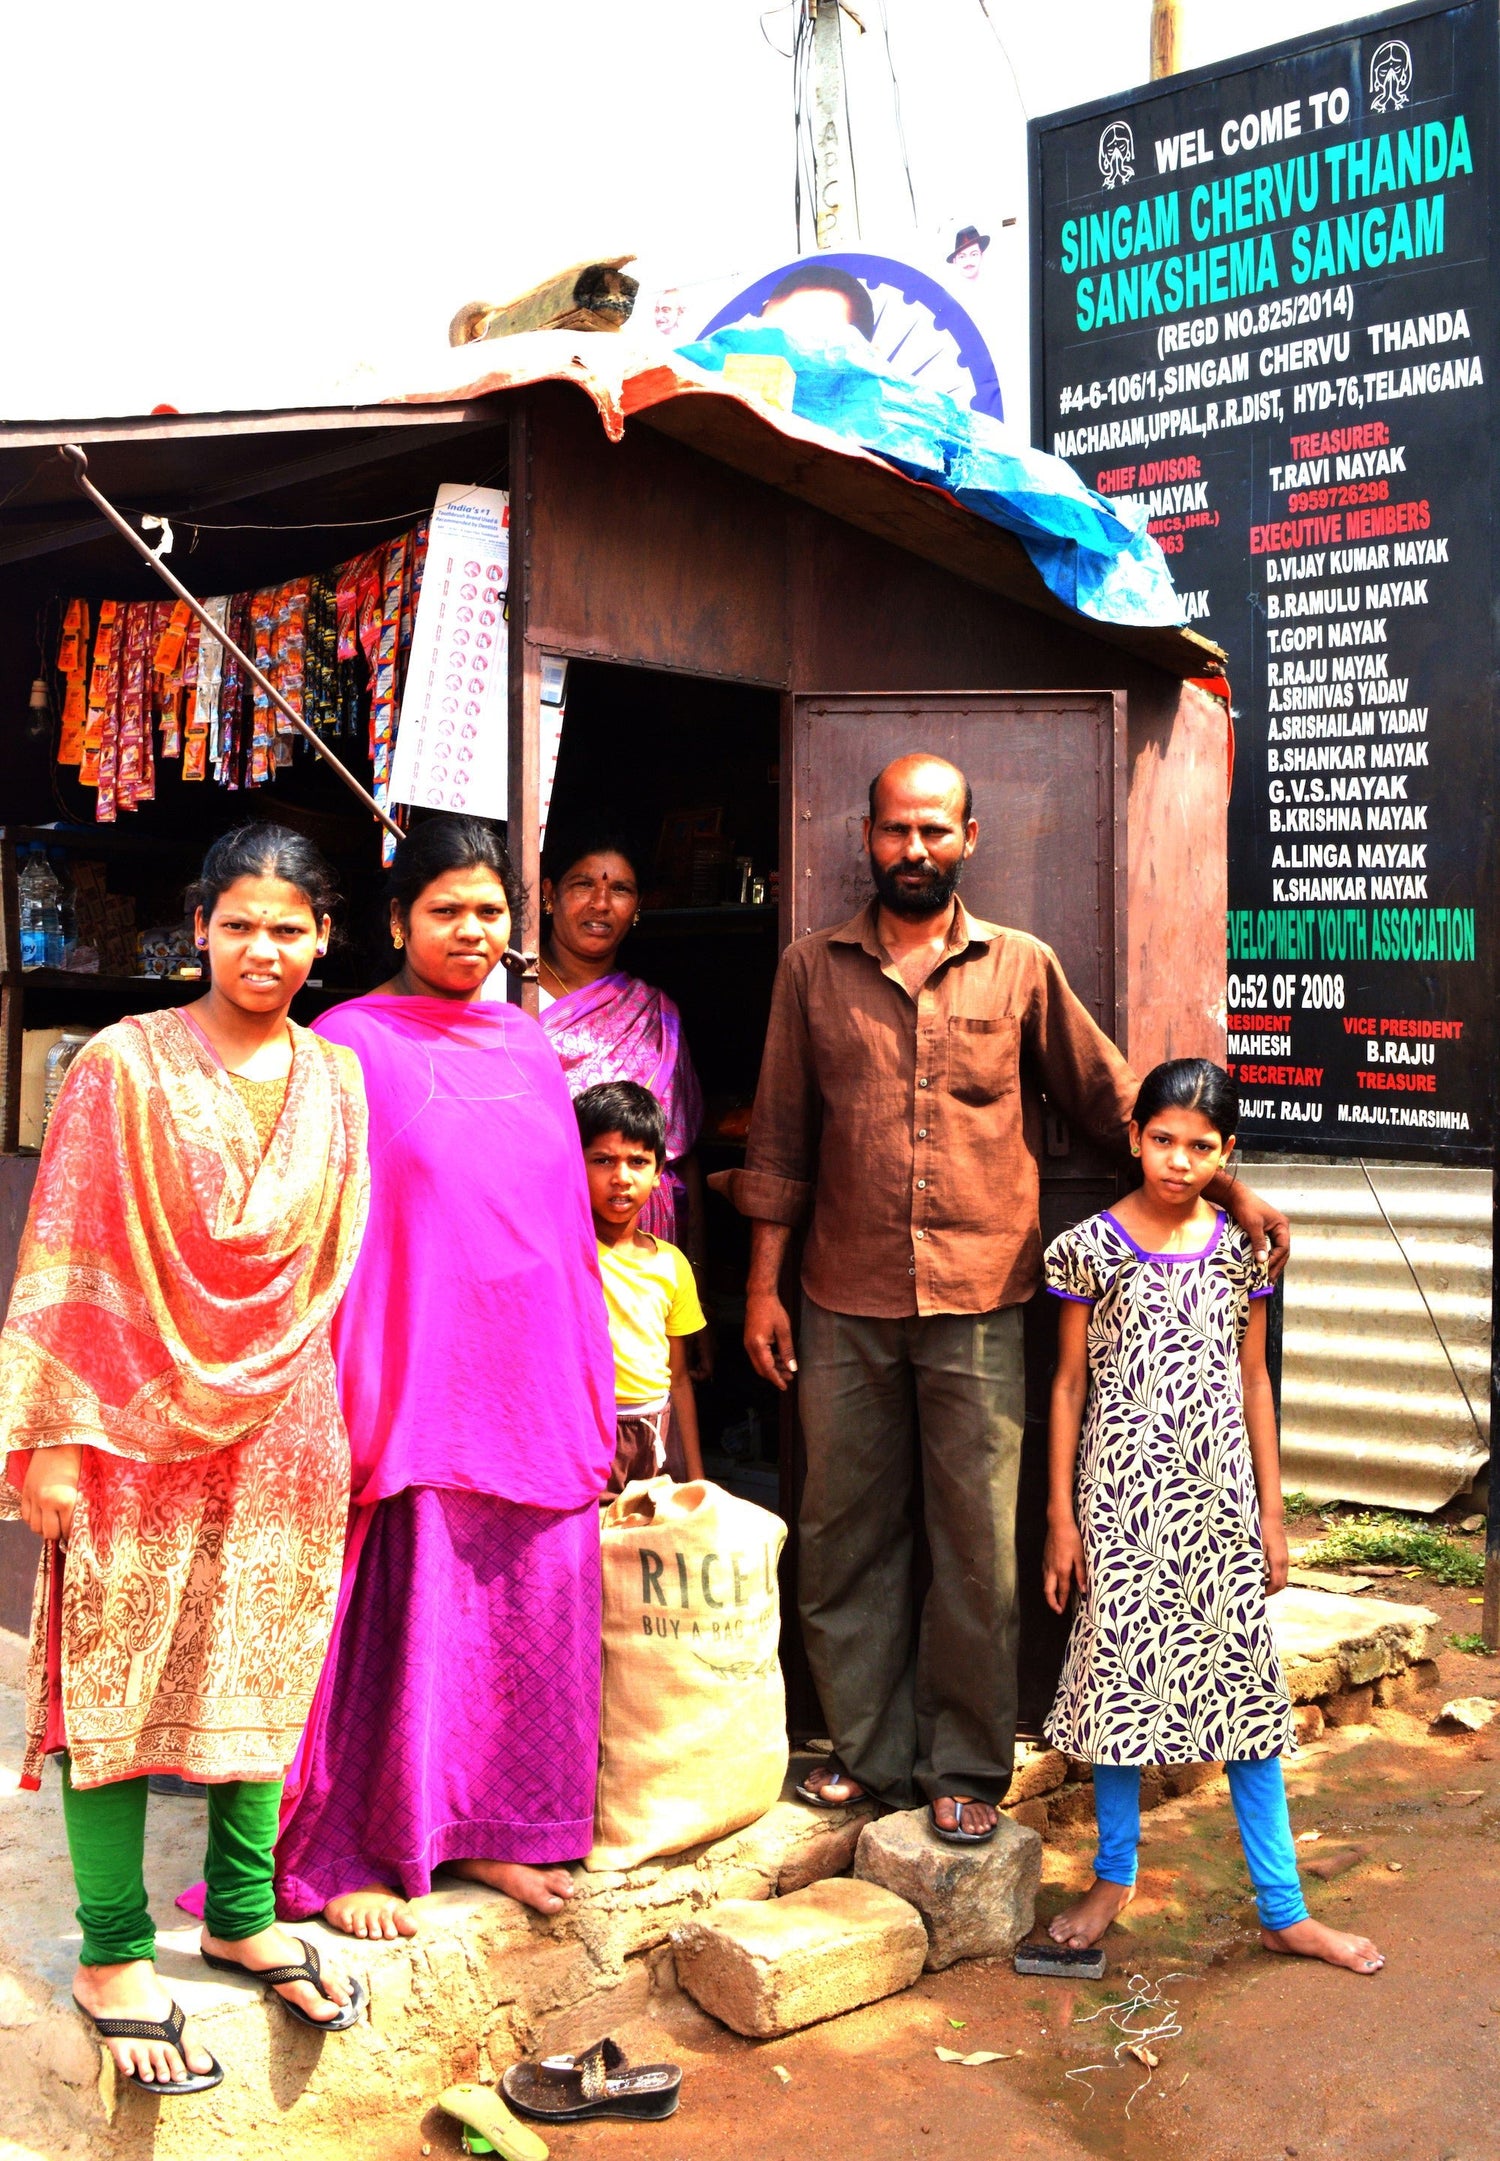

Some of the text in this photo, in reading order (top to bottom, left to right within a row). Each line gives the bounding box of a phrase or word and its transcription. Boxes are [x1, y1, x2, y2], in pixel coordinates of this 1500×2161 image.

[1154, 87, 1350, 174] WEL COME TO
[1061, 115, 1473, 274] SINGAM CHERVU THANDA
[1076, 194, 1445, 332] SANKSHEMA SANGAM
[1157, 284, 1354, 362] (REGD NO.825/2014)
[1259, 331, 1350, 377] CHERVU
[1367, 309, 1471, 355] THANDA
[1290, 421, 1390, 460] TREASURER:
[1097, 455, 1201, 494] CHIEF ADVISOR:
[1269, 446, 1406, 491] T.RAVI NAYAK
[447, 503, 479, 514] India's
[1149, 481, 1209, 518] NAYAK
[1288, 480, 1390, 513] 9959726298
[438, 510, 465, 519] Toothbrush
[1250, 499, 1431, 554] EXECUTIVE MEMBERS
[1267, 538, 1449, 583] D.VIJAY KUMAR NAYAK
[1267, 579, 1429, 619] B.RAMULU NAYAK
[1267, 618, 1388, 653] T.GOPI NAYAK
[1267, 653, 1389, 687] R.RAJU NAYAK
[1268, 678, 1409, 712] A.SRINIVAS YADAV
[1268, 707, 1429, 741] A.SRISHAILAM YADAV
[1267, 741, 1429, 773] B.SHANKAR NAYAK
[1268, 775, 1408, 804] G.V.S.NAYAK
[1269, 805, 1428, 832] B.KRISHNA NAYAK
[1271, 844, 1427, 868] A.LINGA NAYAK
[1272, 875, 1428, 902] K.SHANKAR NAYAK
[1317, 909, 1367, 961] YOUTH
[1371, 907, 1475, 962] ASSOCIATION
[1272, 973, 1296, 1009] OF
[1301, 973, 1345, 1009] 2008
[1343, 1017, 1376, 1035] VICE
[1380, 1019, 1463, 1040] PRESIDENT
[1366, 1040, 1435, 1066] B.RAJU
[1239, 1065, 1324, 1087] SECRETARY
[1356, 1072, 1437, 1092] TREASURE
[1280, 1101, 1323, 1123] RAJU
[639, 1548, 749, 1609] RICE
[643, 1615, 680, 1640] BUY
[692, 1623, 701, 1640] A
